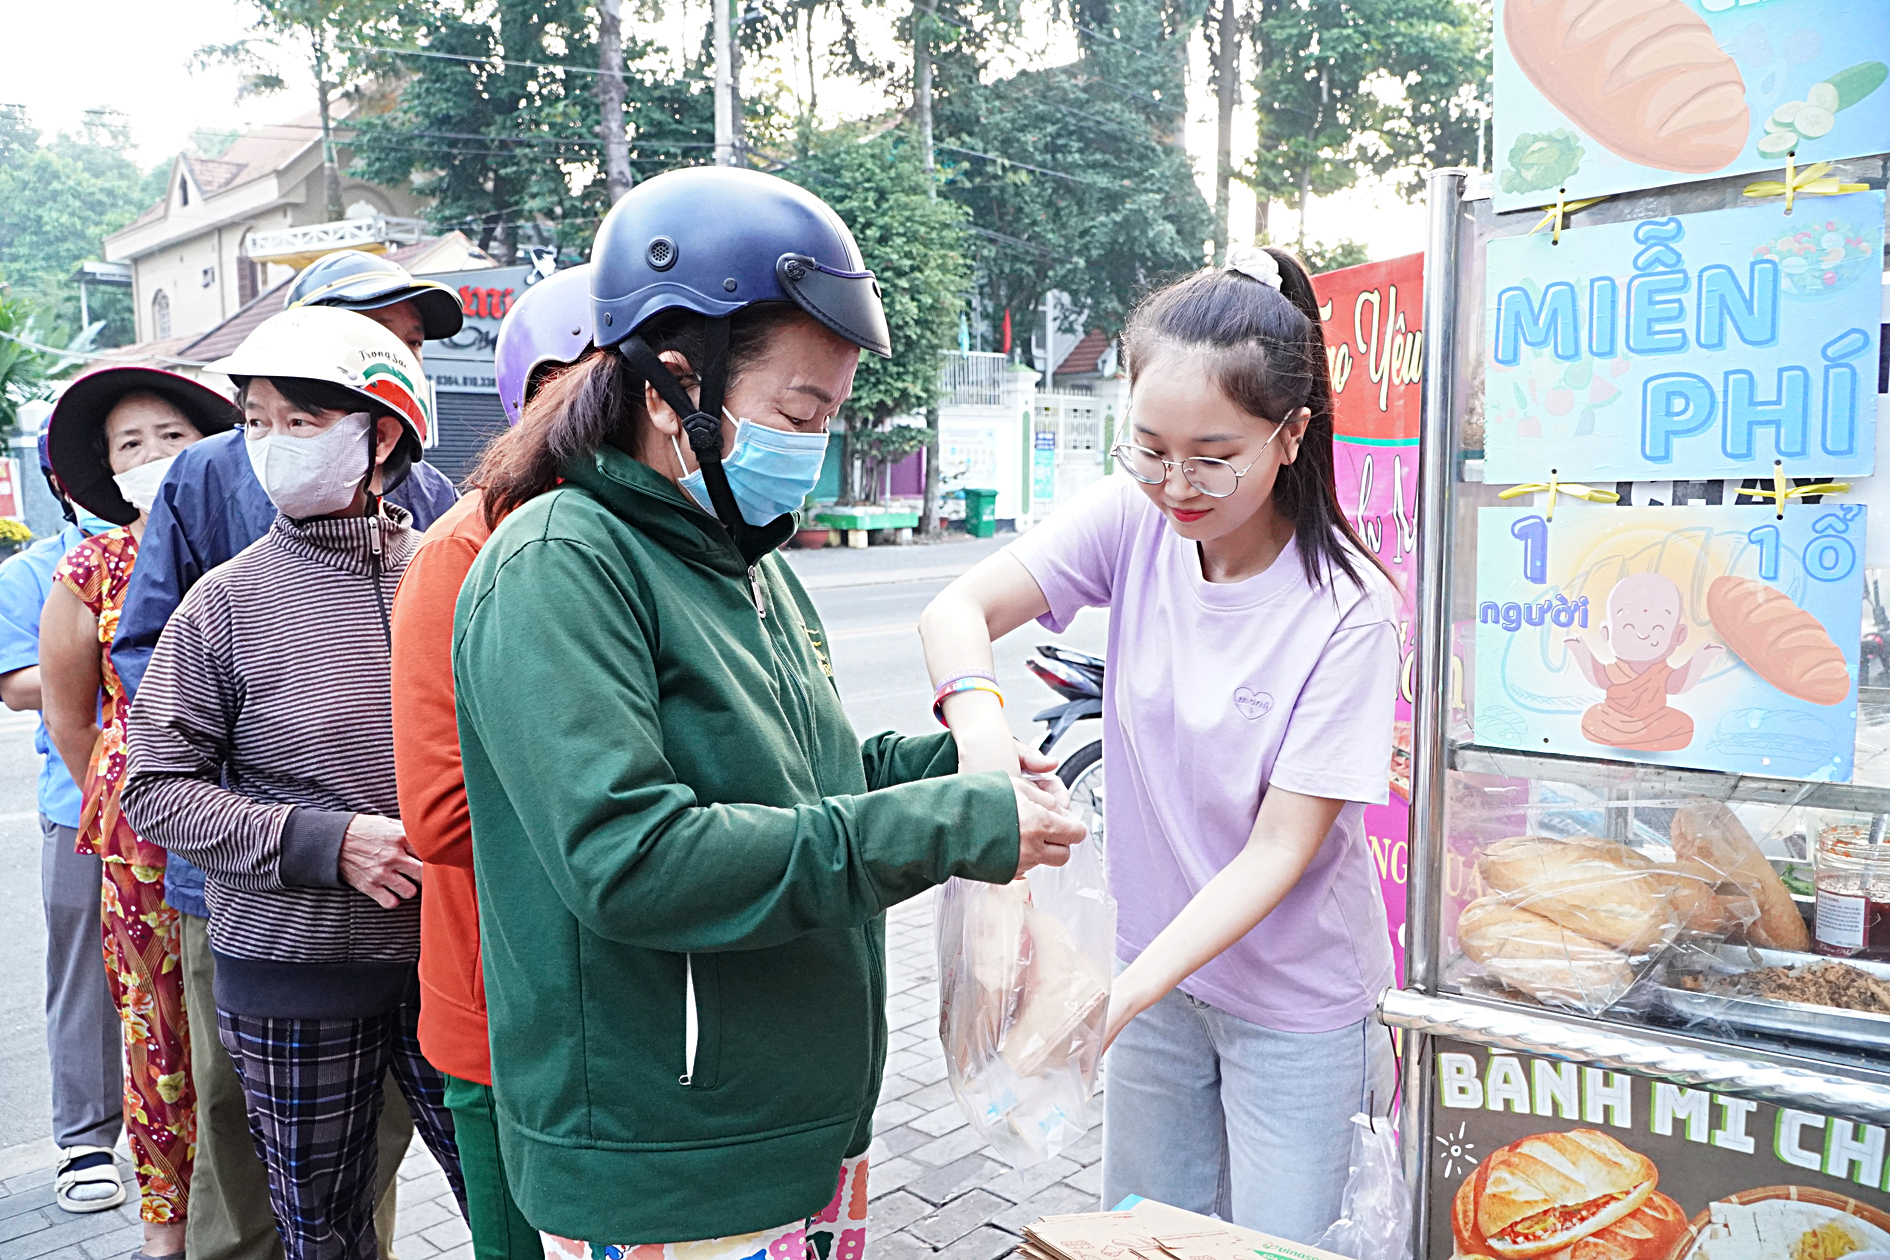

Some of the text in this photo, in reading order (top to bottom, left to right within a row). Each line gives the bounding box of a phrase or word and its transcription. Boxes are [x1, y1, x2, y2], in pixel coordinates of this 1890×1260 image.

[1494, 217, 1781, 366] MIỄN
[1640, 328, 1873, 463] PHÍ
[1511, 514, 1549, 585] 1
[1747, 524, 1780, 581] 1
[1479, 593, 1590, 633] người
[1774, 1107, 1890, 1193] CH
